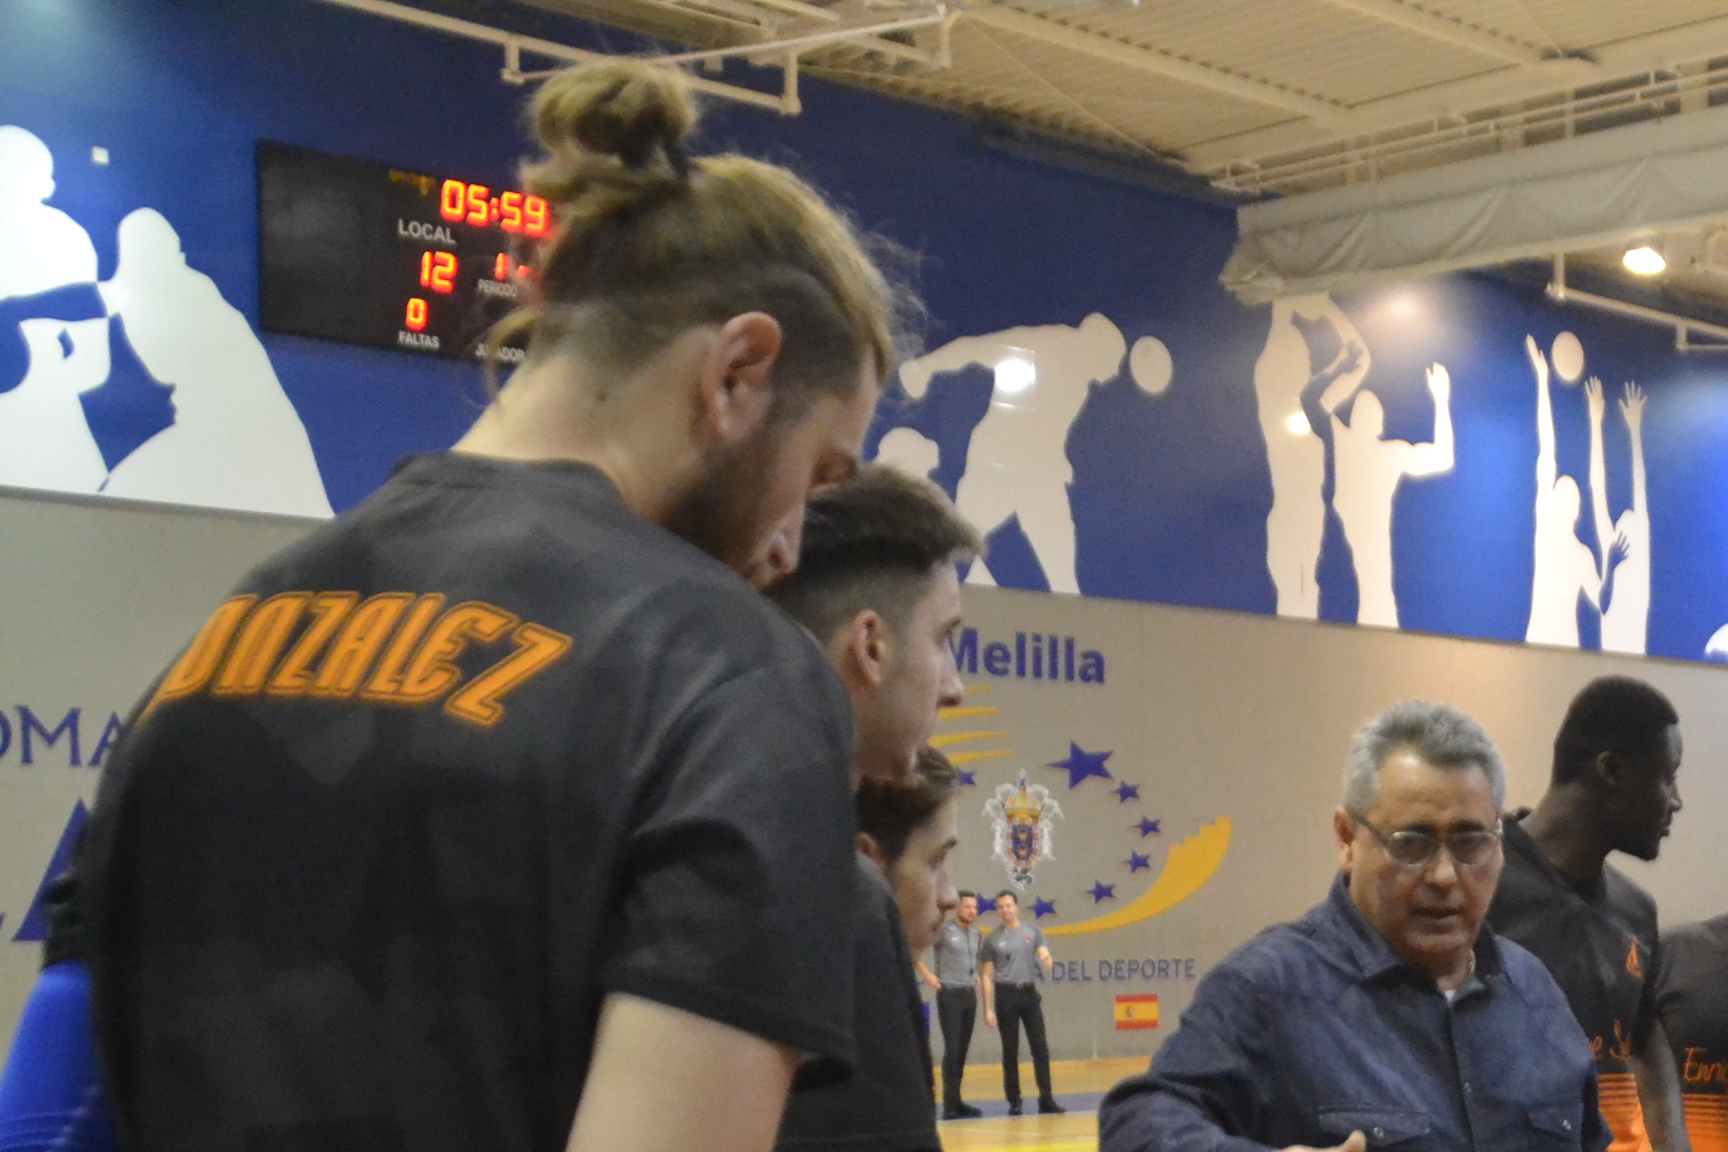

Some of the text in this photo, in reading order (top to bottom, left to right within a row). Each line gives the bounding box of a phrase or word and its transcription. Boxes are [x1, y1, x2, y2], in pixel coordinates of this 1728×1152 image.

[440, 179, 550, 237] 05:59
[398, 218, 456, 245] LOCAL
[420, 251, 459, 293] 12
[405, 297, 428, 331] 0
[397, 330, 440, 349] FALTAS
[475, 343, 525, 361] JUADOR
[133, 590, 573, 727] ONZALEZ
[948, 626, 1105, 683] Melilla
[1051, 960, 1092, 982] DEL
[1099, 958, 1196, 981] DEPORTE
